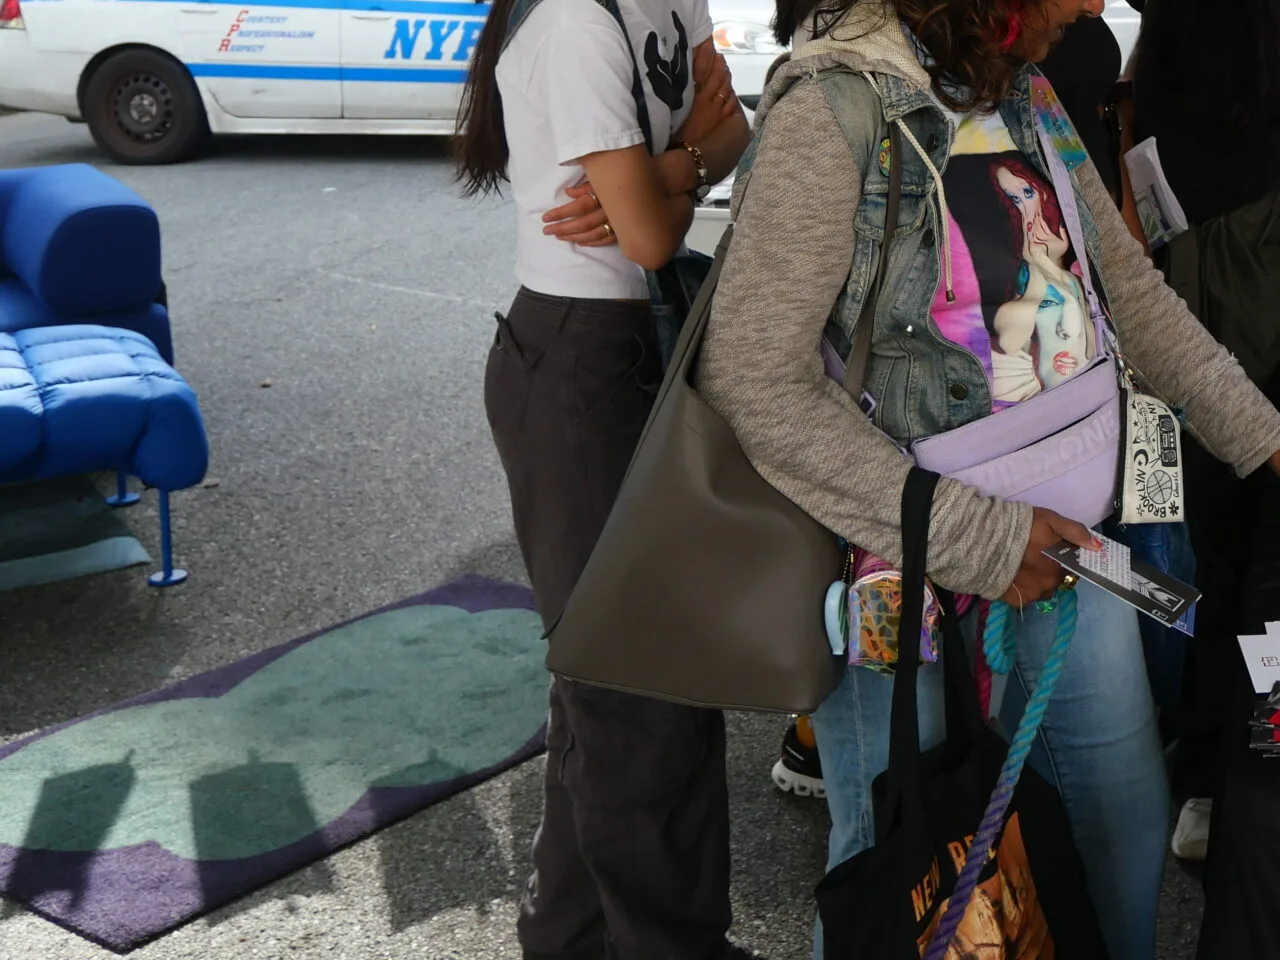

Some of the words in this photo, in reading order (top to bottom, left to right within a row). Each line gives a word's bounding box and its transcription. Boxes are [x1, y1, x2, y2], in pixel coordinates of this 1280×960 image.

[1147, 401, 1157, 415] NY
[1135, 468, 1167, 518] BROOKLYN
[911, 854, 940, 922] NEW
